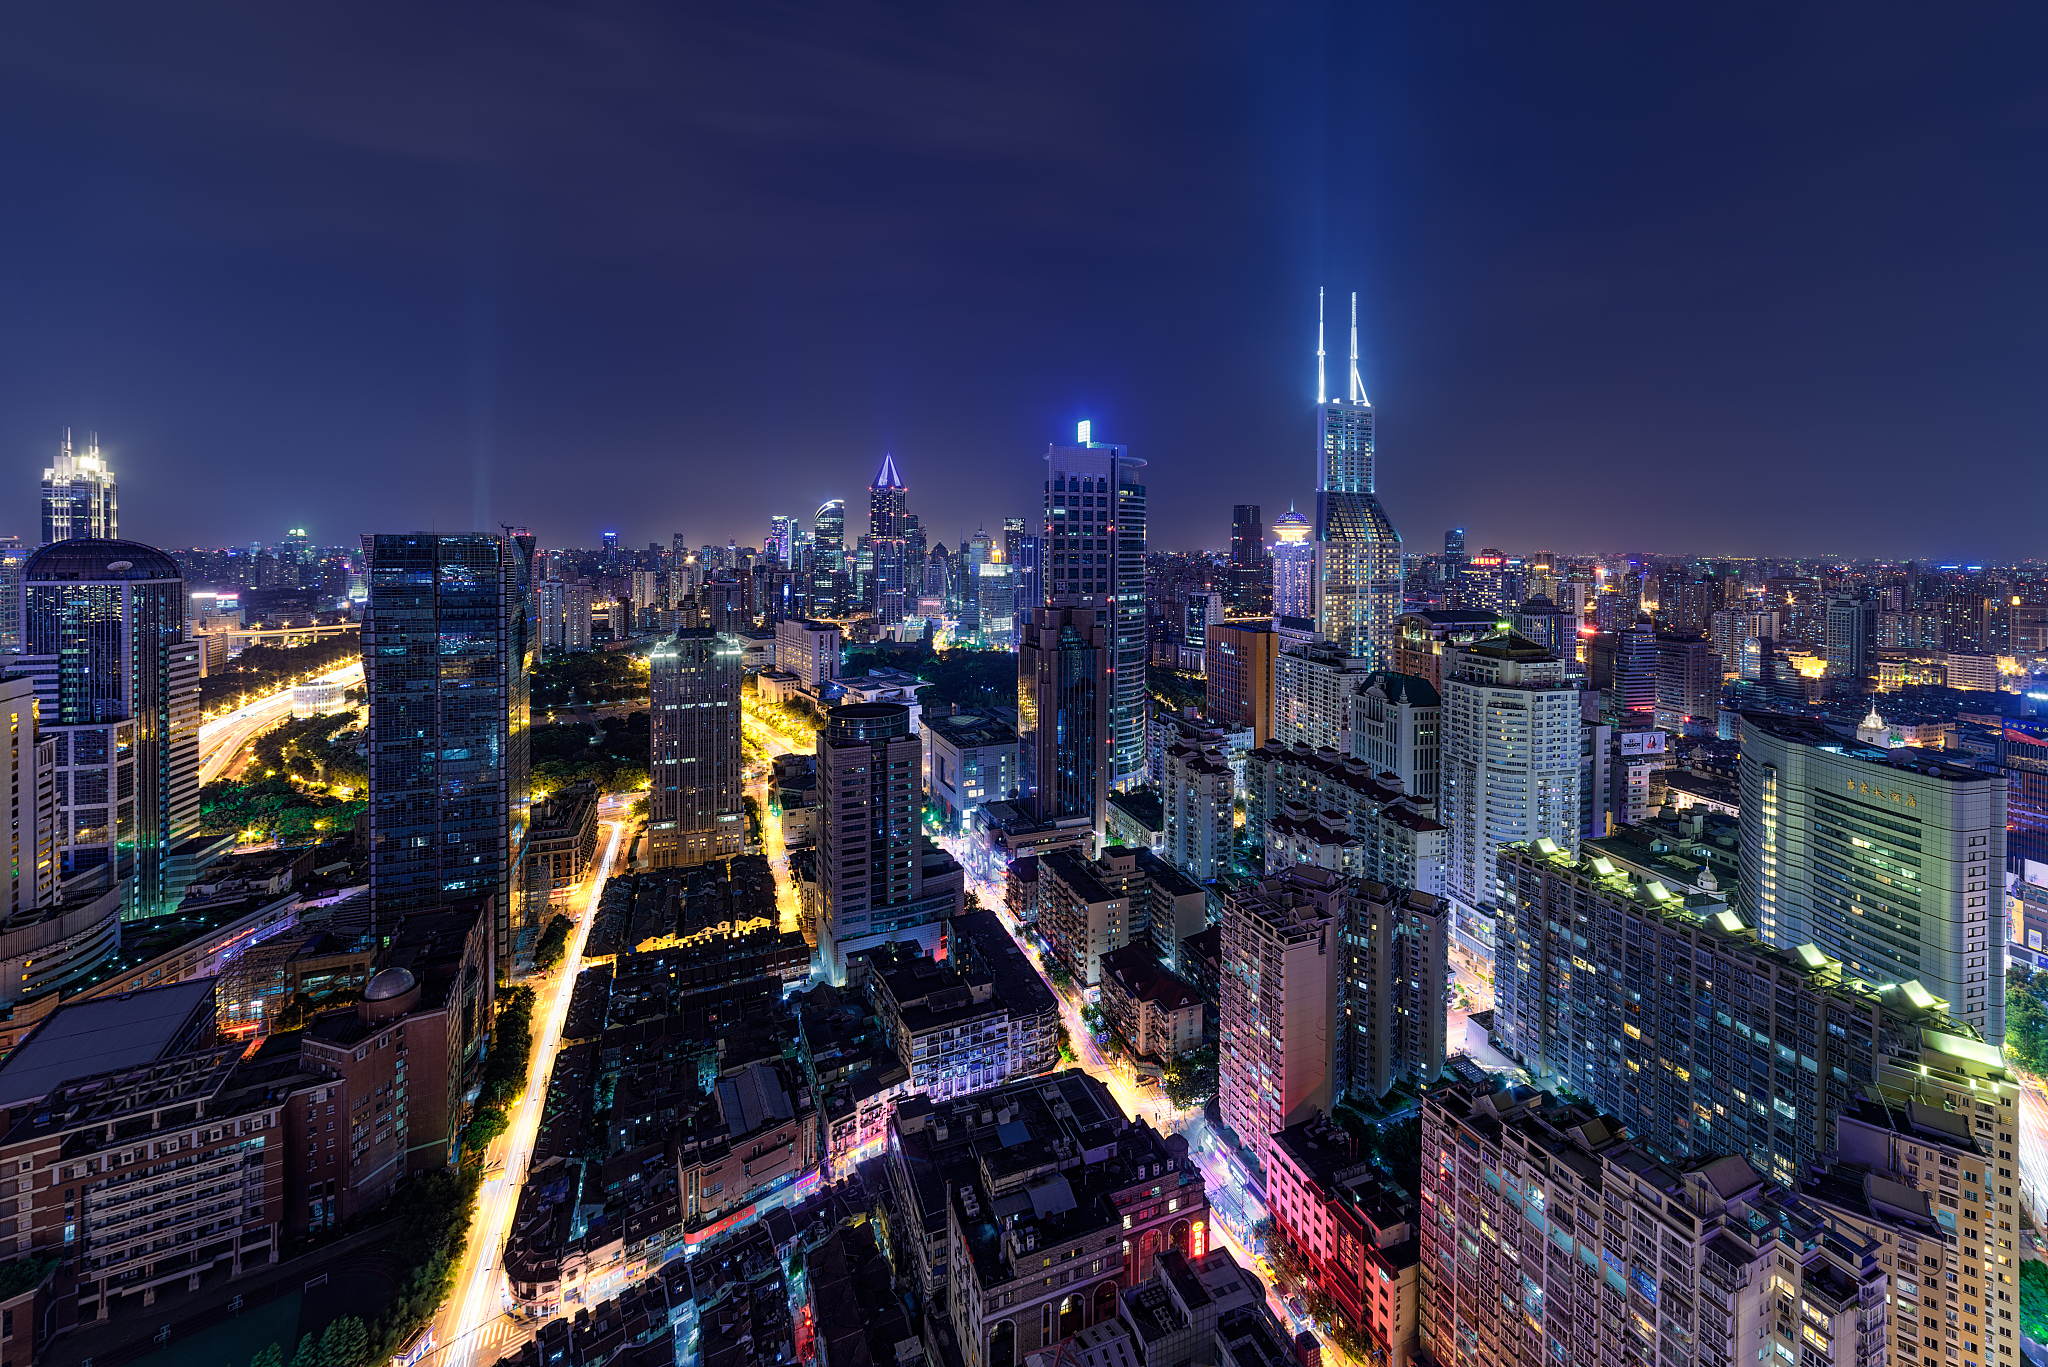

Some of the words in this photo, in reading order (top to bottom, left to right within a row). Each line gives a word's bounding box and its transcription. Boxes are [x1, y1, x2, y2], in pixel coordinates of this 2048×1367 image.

[1846, 777, 1917, 807] 古象大酒店
